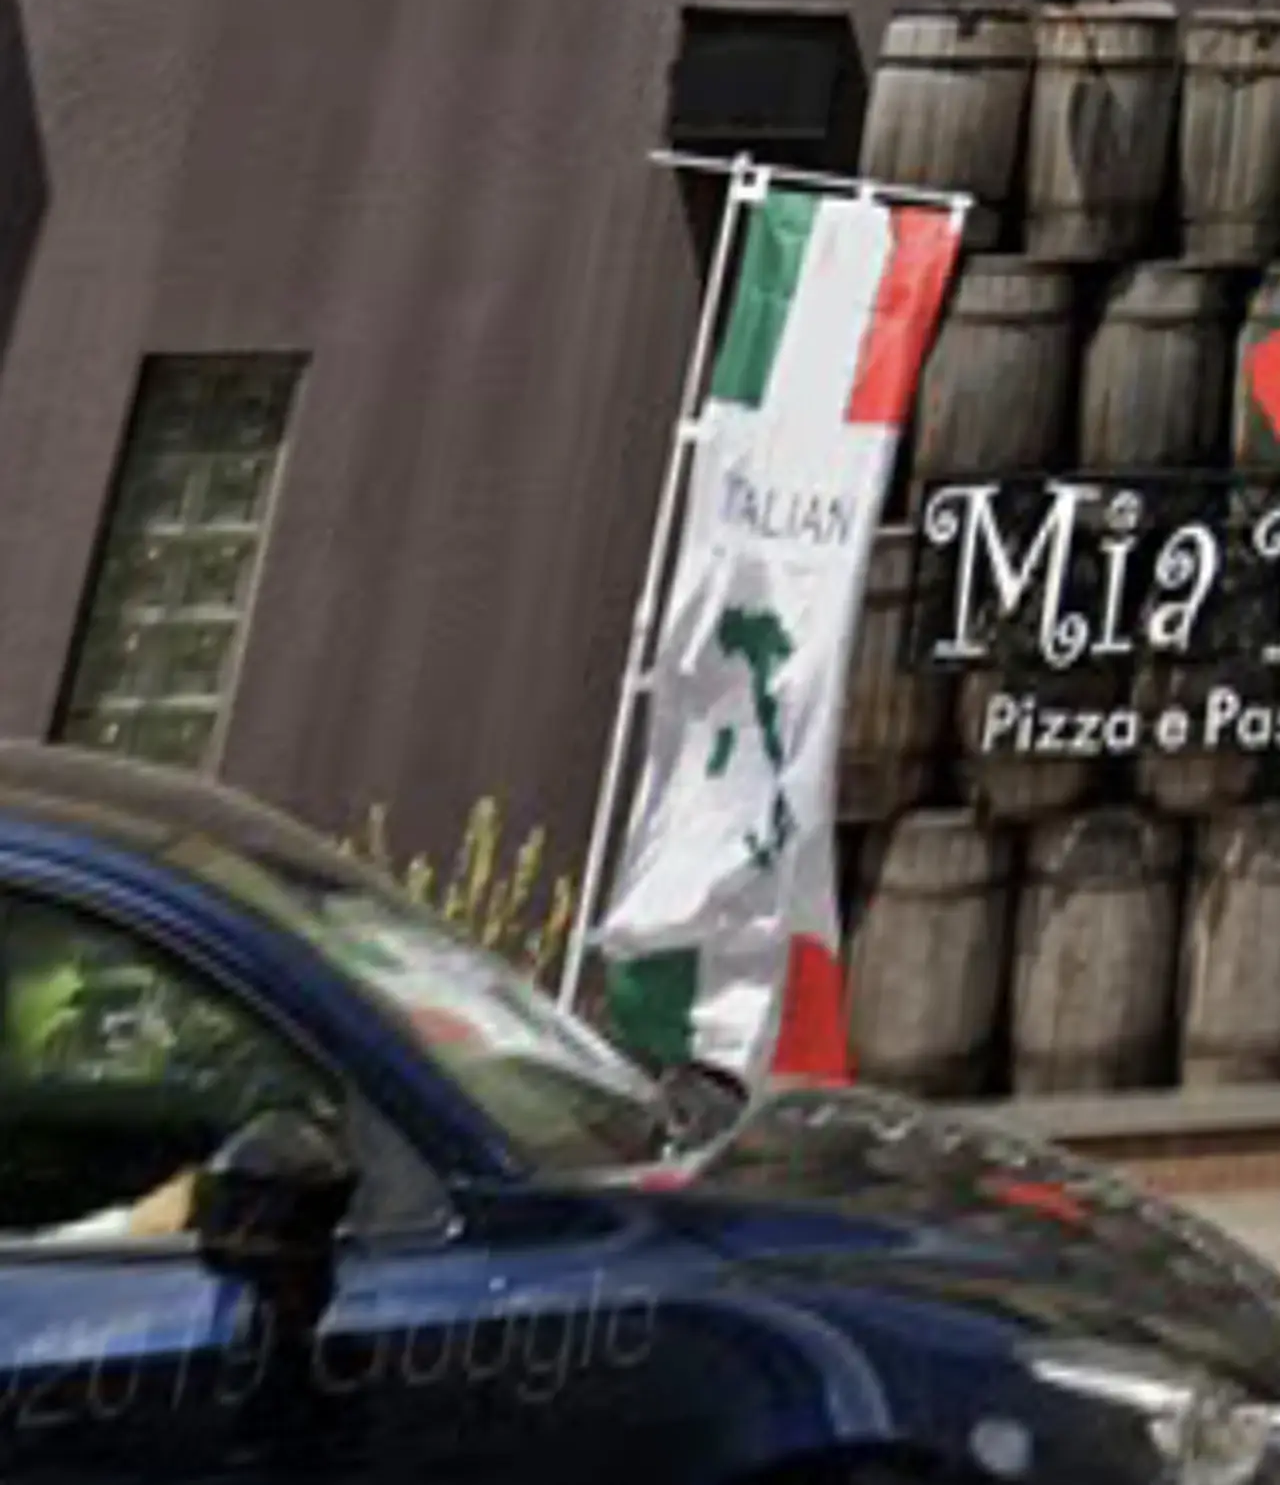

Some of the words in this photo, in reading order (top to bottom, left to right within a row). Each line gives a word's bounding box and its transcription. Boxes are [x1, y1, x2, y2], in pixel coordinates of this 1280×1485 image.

[923, 481, 1221, 669] Mia
[979, 691, 1139, 755] Pizza
[1155, 701, 1190, 744] e
